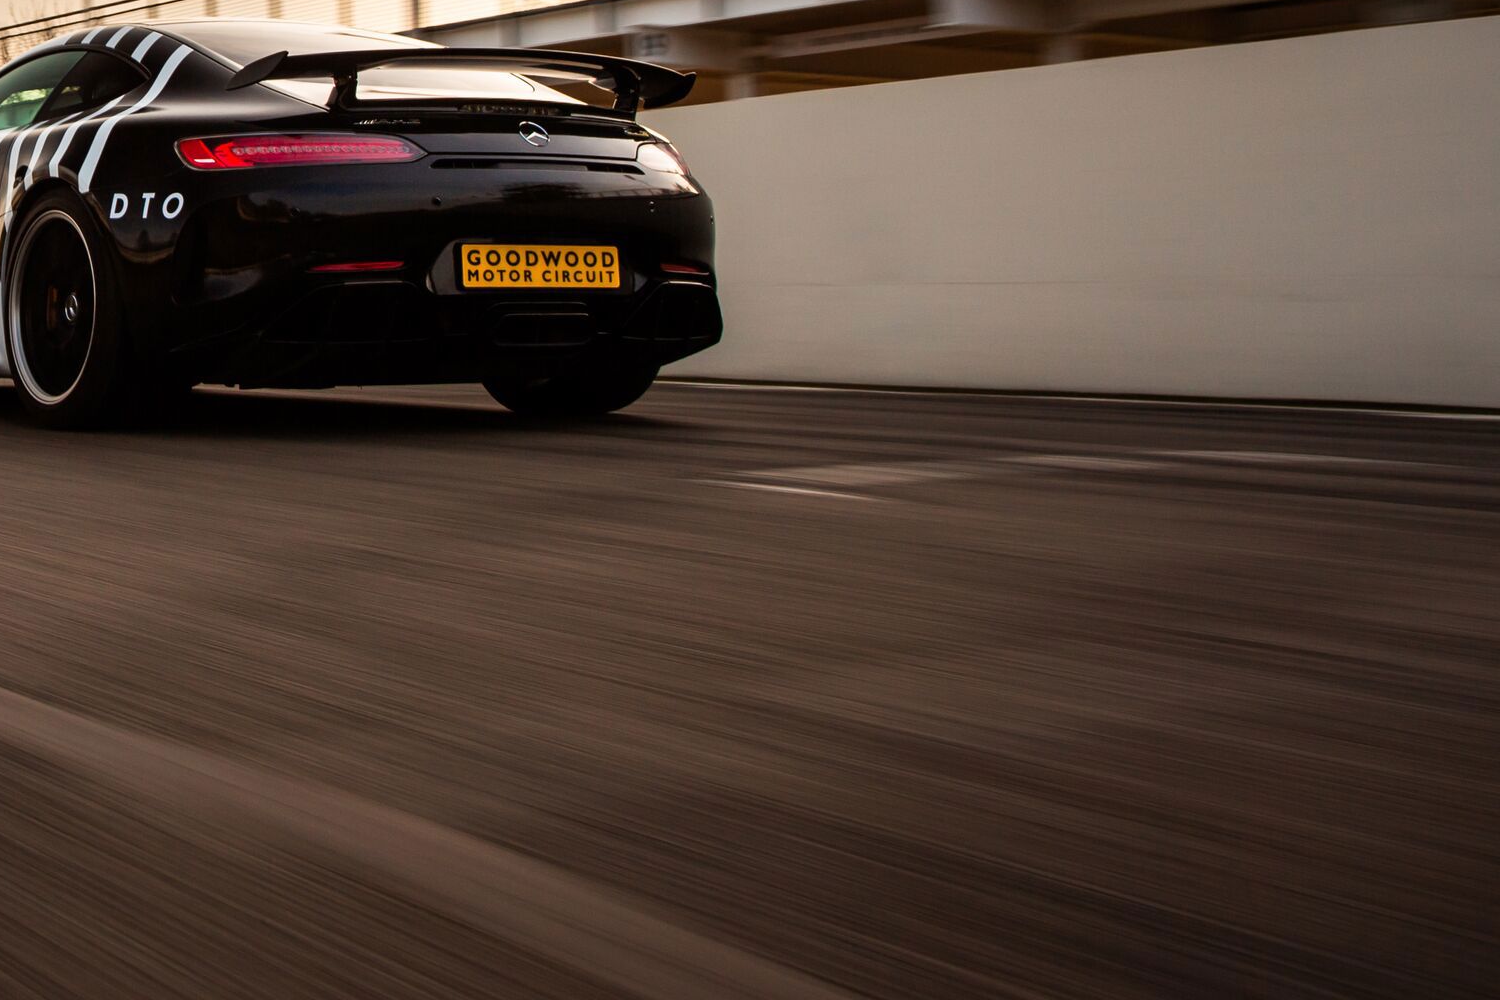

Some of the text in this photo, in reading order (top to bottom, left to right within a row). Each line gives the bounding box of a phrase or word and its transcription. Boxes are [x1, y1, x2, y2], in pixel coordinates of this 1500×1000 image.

[109, 192, 184, 219] DTO
[466, 249, 615, 268] GOODWOOD
[467, 269, 615, 283] MOTOR CIRCUIT
